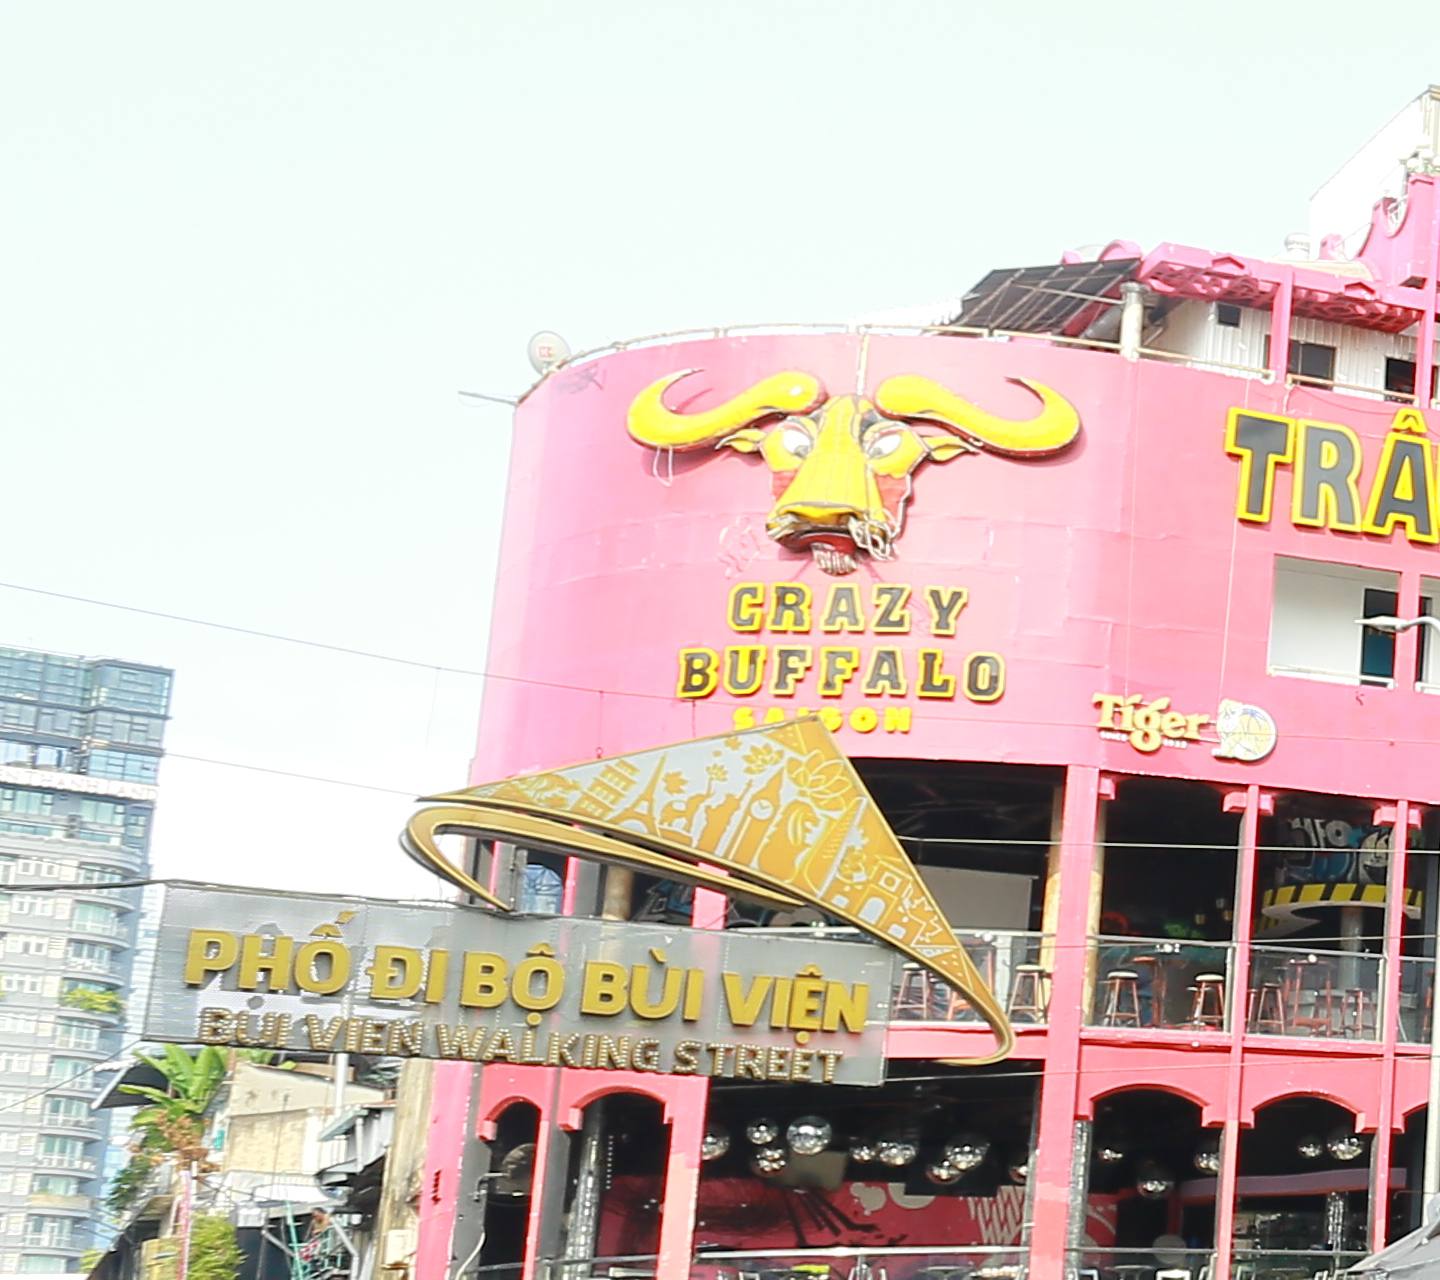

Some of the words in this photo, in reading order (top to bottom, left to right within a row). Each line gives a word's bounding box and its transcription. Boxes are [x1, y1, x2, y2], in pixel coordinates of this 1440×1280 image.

[727, 581, 969, 637] CRAZY
[675, 644, 1006, 704] BUFFALO
[1091, 692, 1211, 752] Tiger
[184, 910, 357, 995] PHỐ
[365, 945, 446, 1004] ĐI
[460, 942, 565, 1027] BỘ
[581, 947, 704, 1023] BÙI
[723, 963, 870, 1045] VIỆN
[200, 1007, 293, 1048] BUI
[305, 1014, 424, 1056] VIEN
[434, 1023, 660, 1074] WALKING
[674, 1038, 845, 1085] STREET
